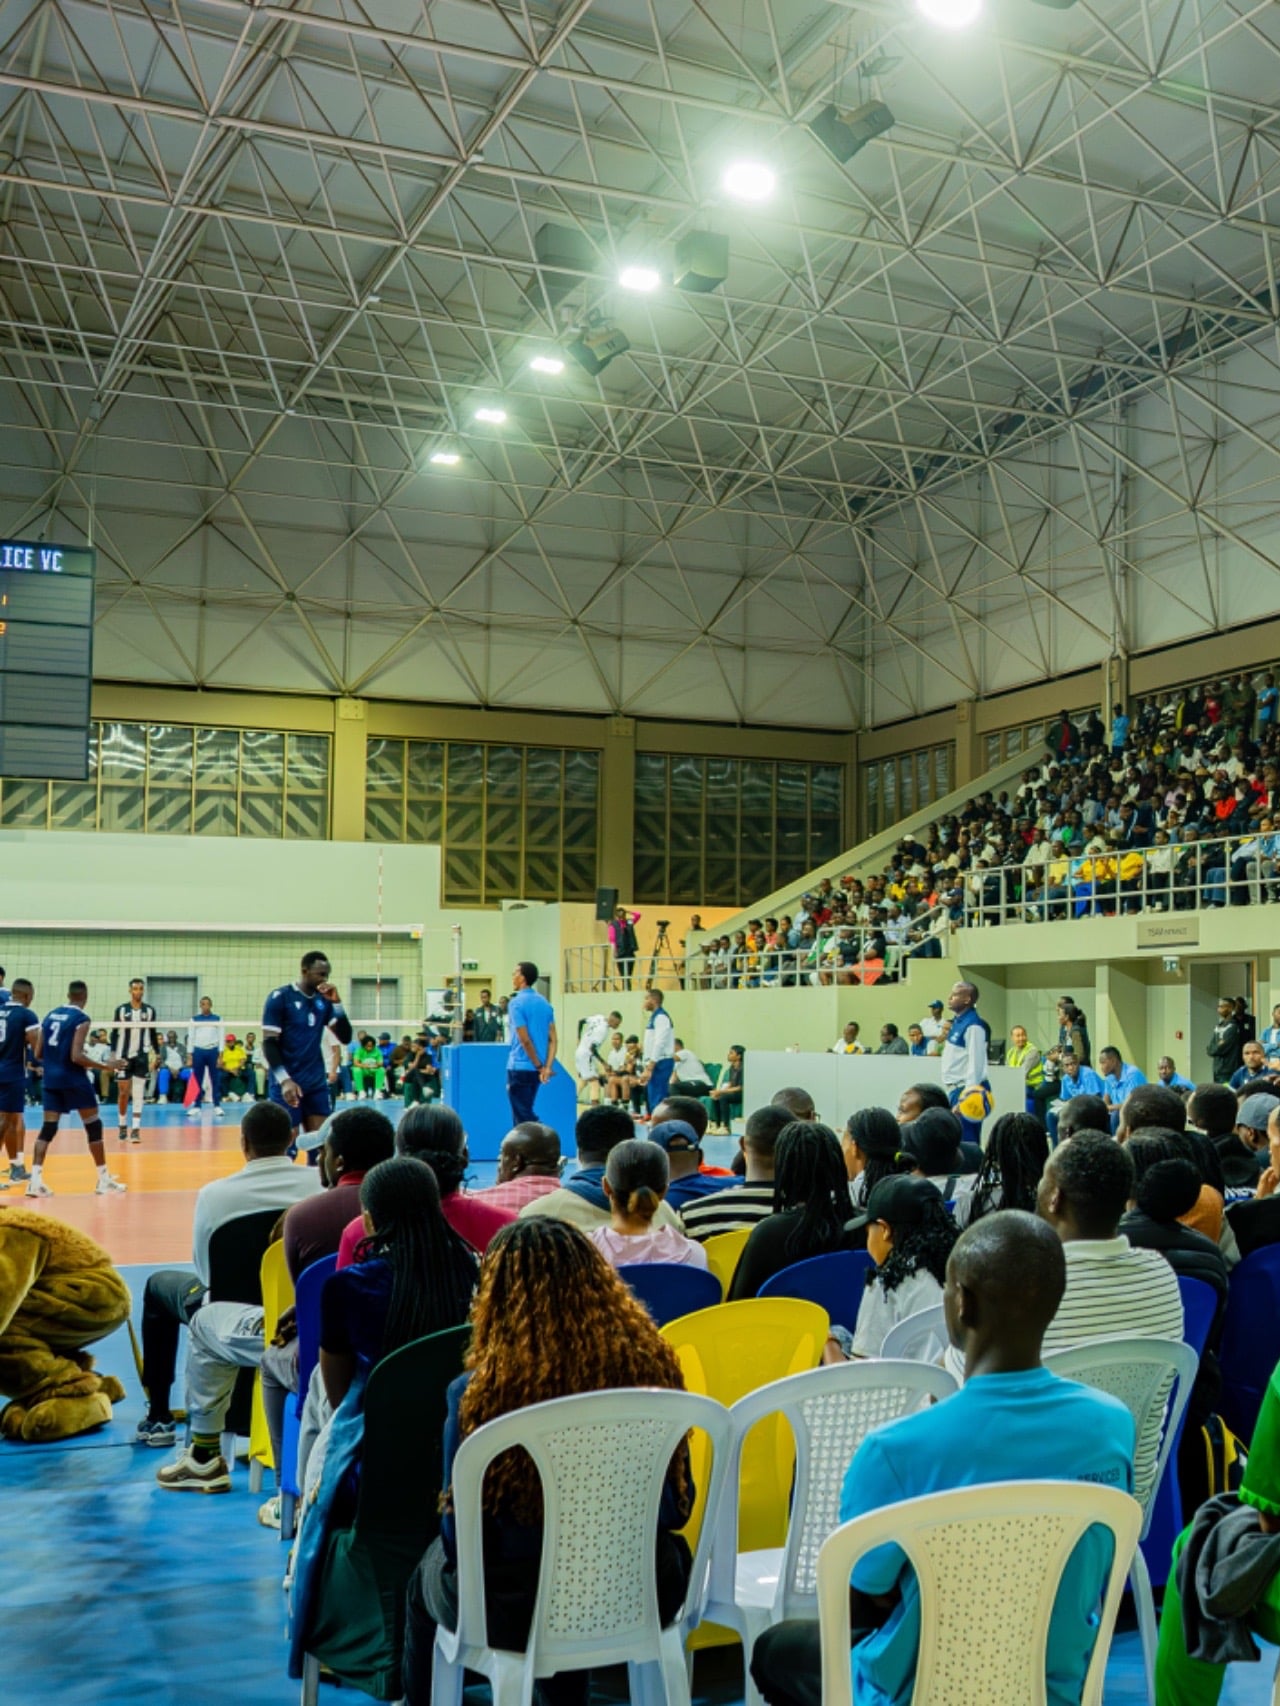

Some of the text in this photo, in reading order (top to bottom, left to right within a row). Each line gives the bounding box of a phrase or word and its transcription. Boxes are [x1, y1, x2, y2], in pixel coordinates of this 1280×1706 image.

[0, 546, 63, 572] ICE VC
[48, 1021, 61, 1046] 2
